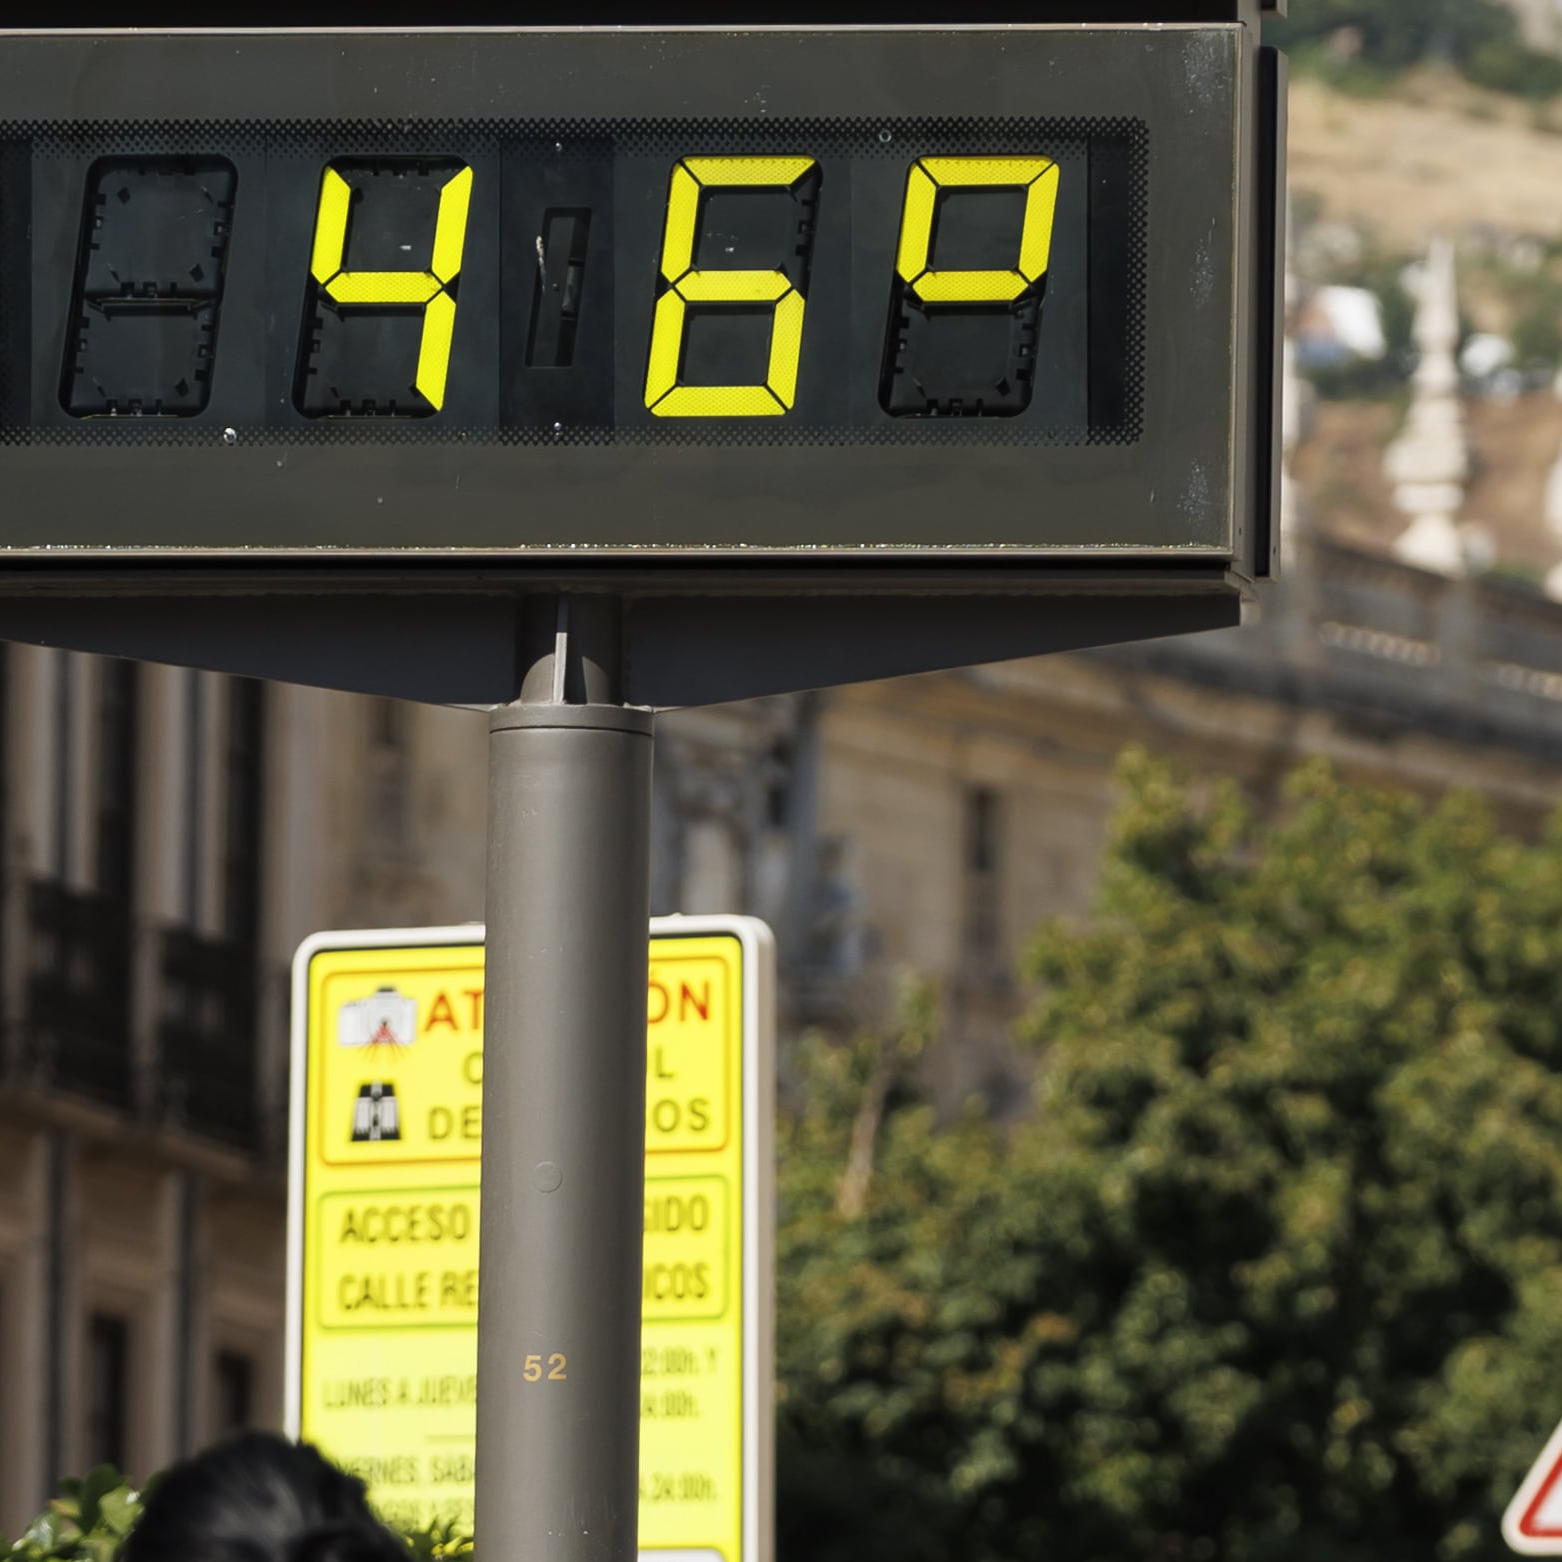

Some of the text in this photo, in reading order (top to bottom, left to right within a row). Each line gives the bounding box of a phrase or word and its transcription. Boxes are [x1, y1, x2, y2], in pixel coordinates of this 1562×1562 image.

[340, 1203, 470, 1243] ACCESO
[338, 1270, 430, 1311] CALLE
[522, 1353, 567, 1382] 52
